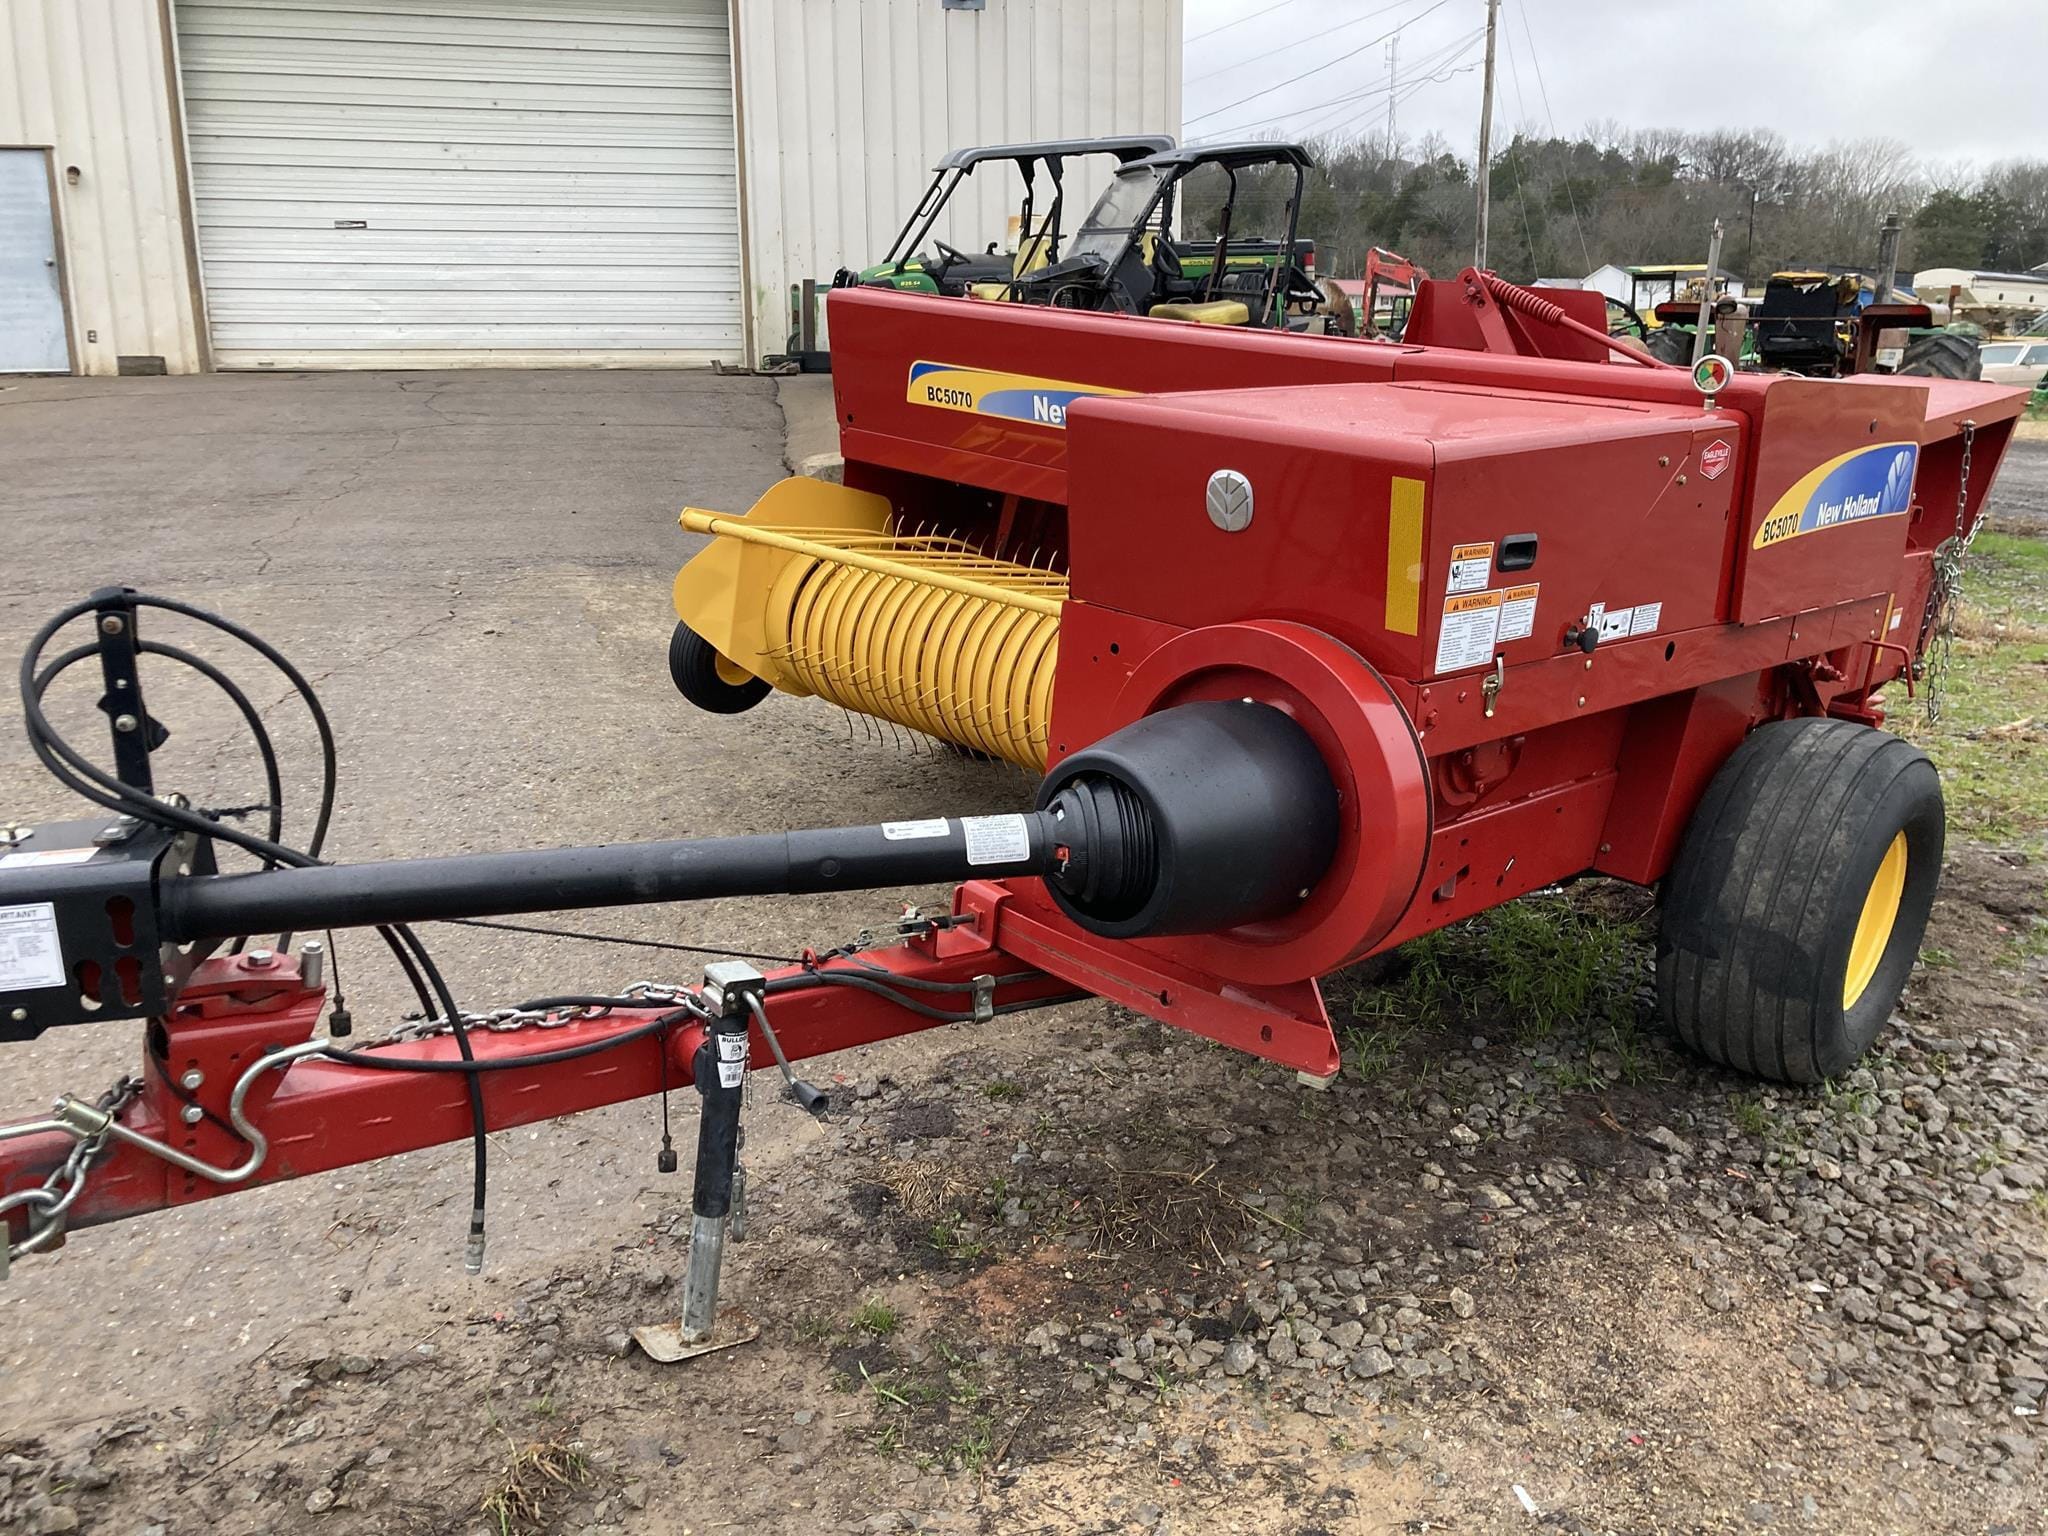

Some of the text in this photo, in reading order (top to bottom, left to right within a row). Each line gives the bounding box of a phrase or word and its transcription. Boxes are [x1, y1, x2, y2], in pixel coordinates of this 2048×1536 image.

[927, 386, 1067, 424] BC5070 Ne
[1762, 491, 1882, 543] BC5070 New Holland
[1464, 547, 1490, 557] WARNING
[1512, 588, 1536, 599] WARNING
[1462, 596, 1493, 609] WARNING
[721, 1035, 748, 1043] BULLDO
